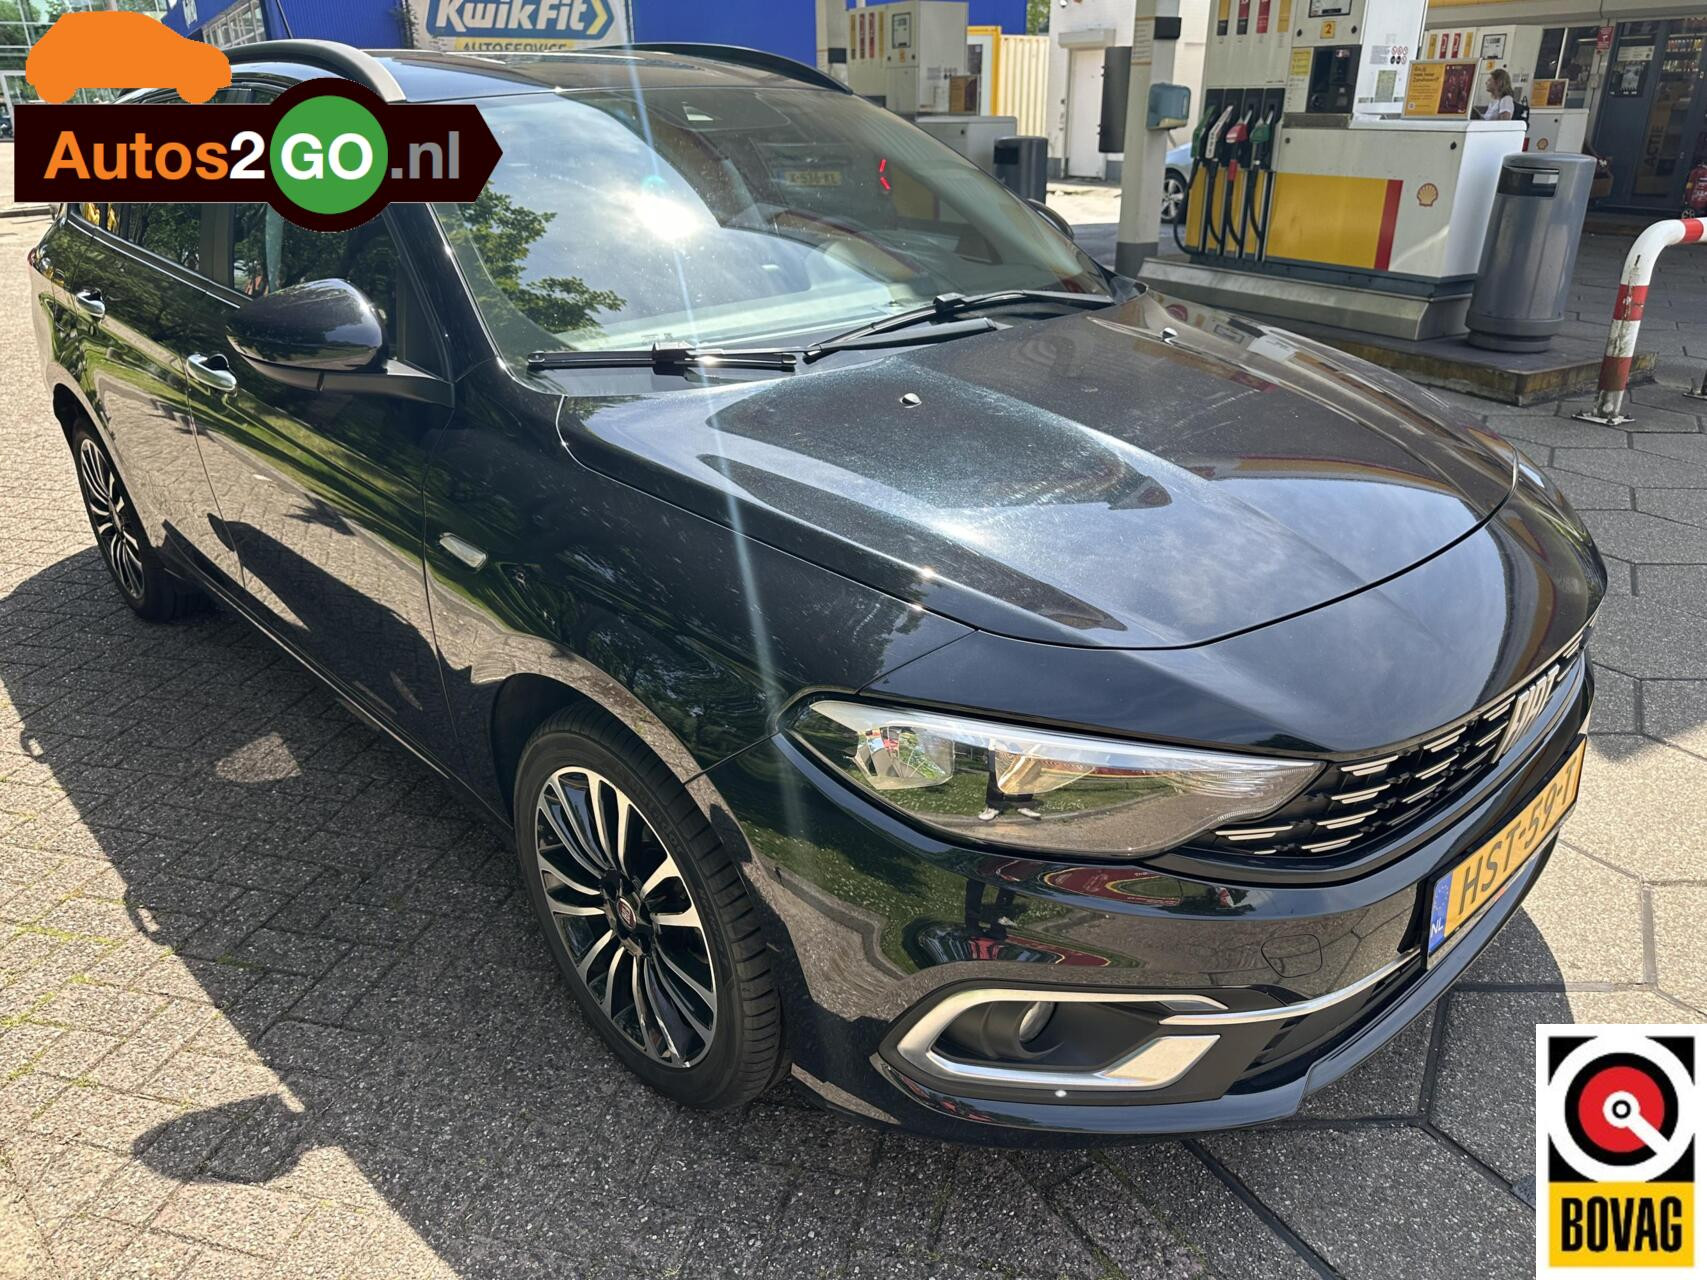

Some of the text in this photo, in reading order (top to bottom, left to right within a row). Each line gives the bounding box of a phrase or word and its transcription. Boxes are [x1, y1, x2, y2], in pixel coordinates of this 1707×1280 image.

[1324, 23, 1333, 34] 2
[1457, 756, 1577, 915] HST-59-T
[1430, 917, 1444, 937] NL
